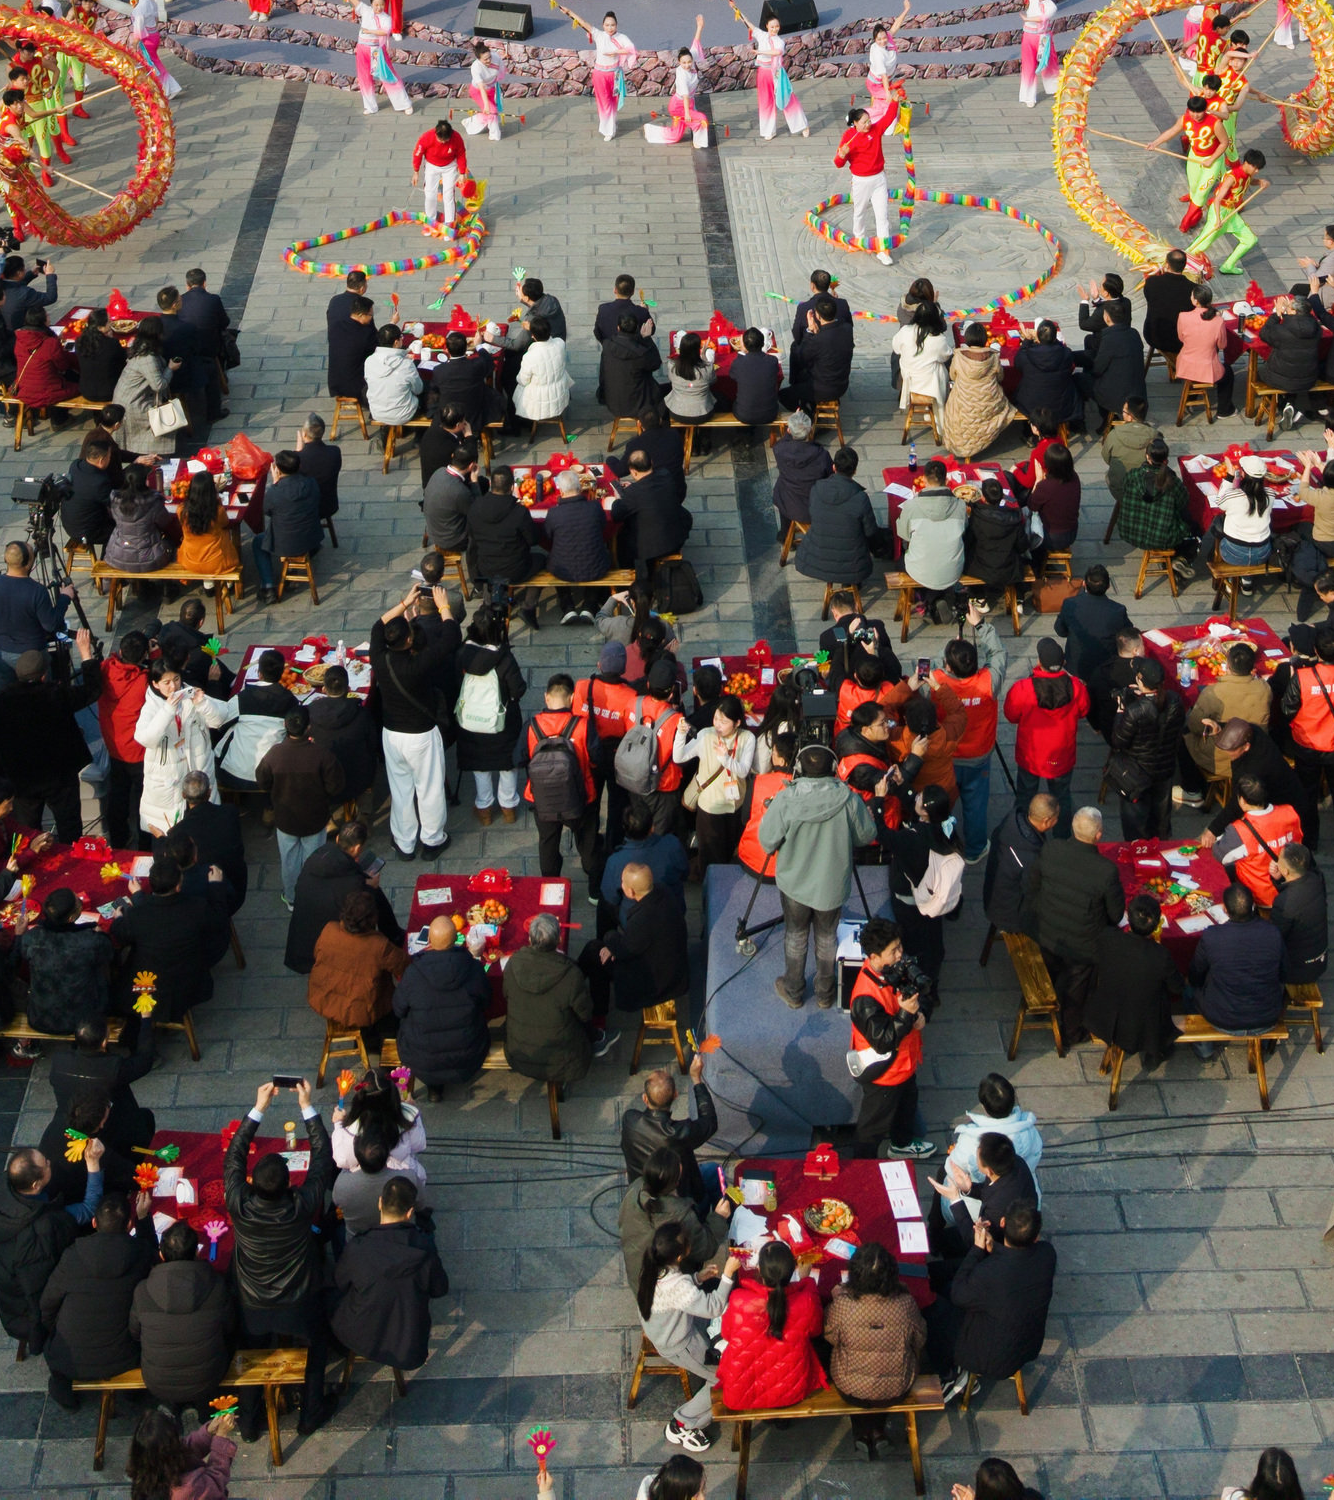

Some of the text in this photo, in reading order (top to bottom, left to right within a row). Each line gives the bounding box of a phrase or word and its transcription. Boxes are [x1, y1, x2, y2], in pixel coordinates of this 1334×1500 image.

[1233, 449, 1242, 457] 11
[84, 842, 96, 850] 23
[1136, 846, 1148, 854] 22
[483, 875, 495, 883] 21
